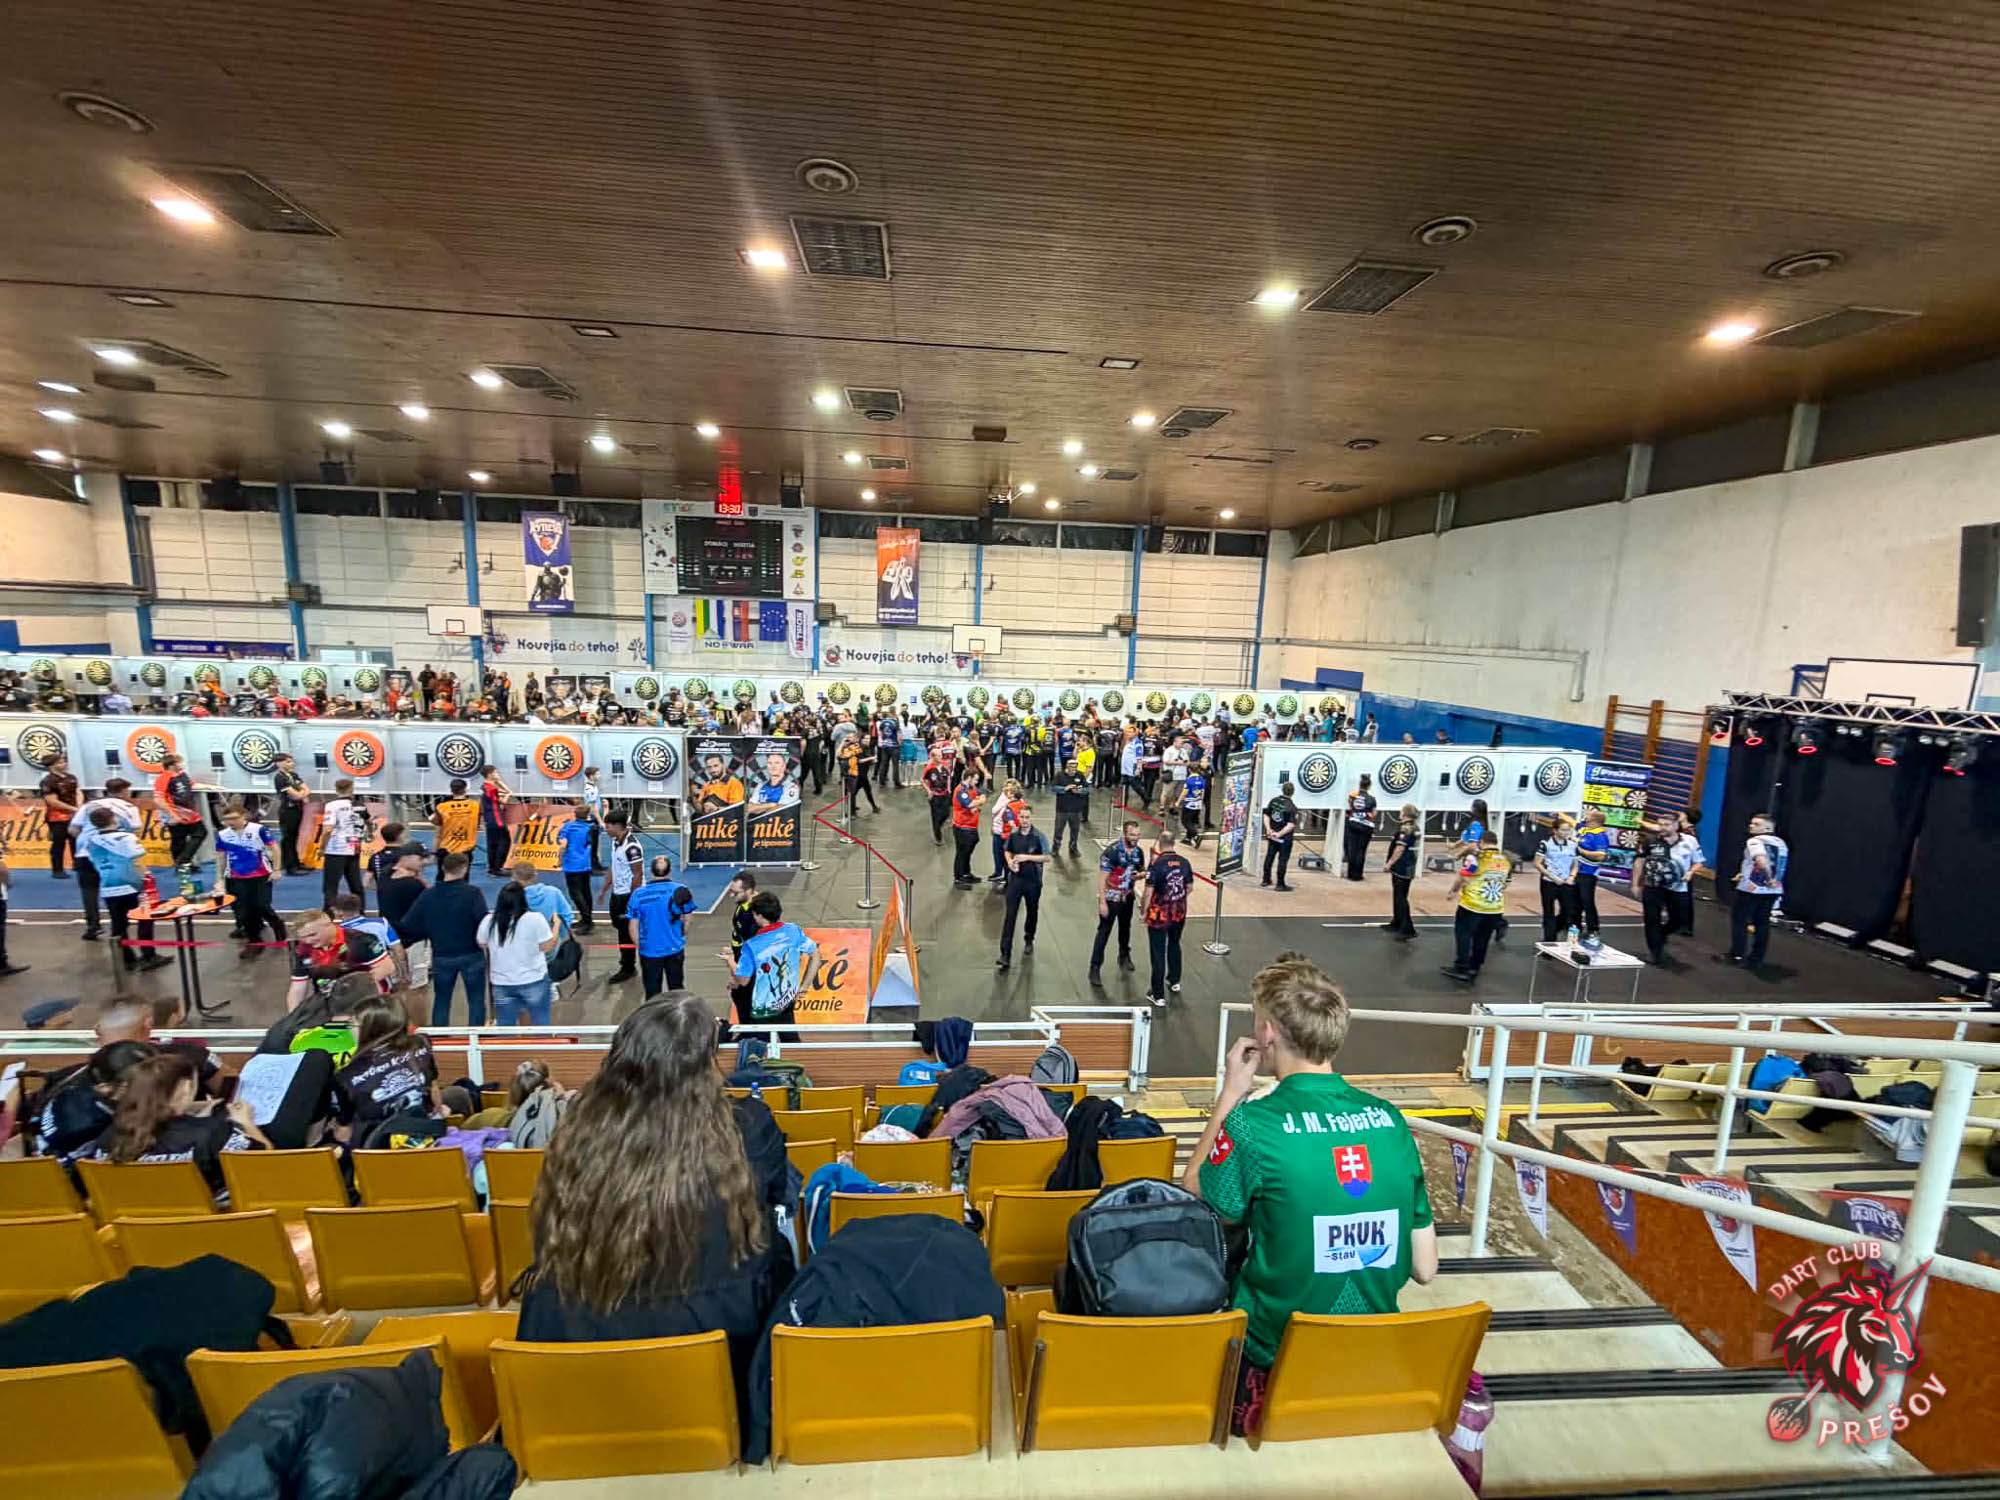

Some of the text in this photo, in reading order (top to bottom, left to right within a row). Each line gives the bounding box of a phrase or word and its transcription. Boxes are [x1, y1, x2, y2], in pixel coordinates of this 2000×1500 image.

[696, 817, 738, 839] niké
[753, 816, 795, 839] niké
[793, 996, 844, 1011] ovanie
[1282, 1112, 1302, 1133] J.
[1302, 1111, 1328, 1133] M.
